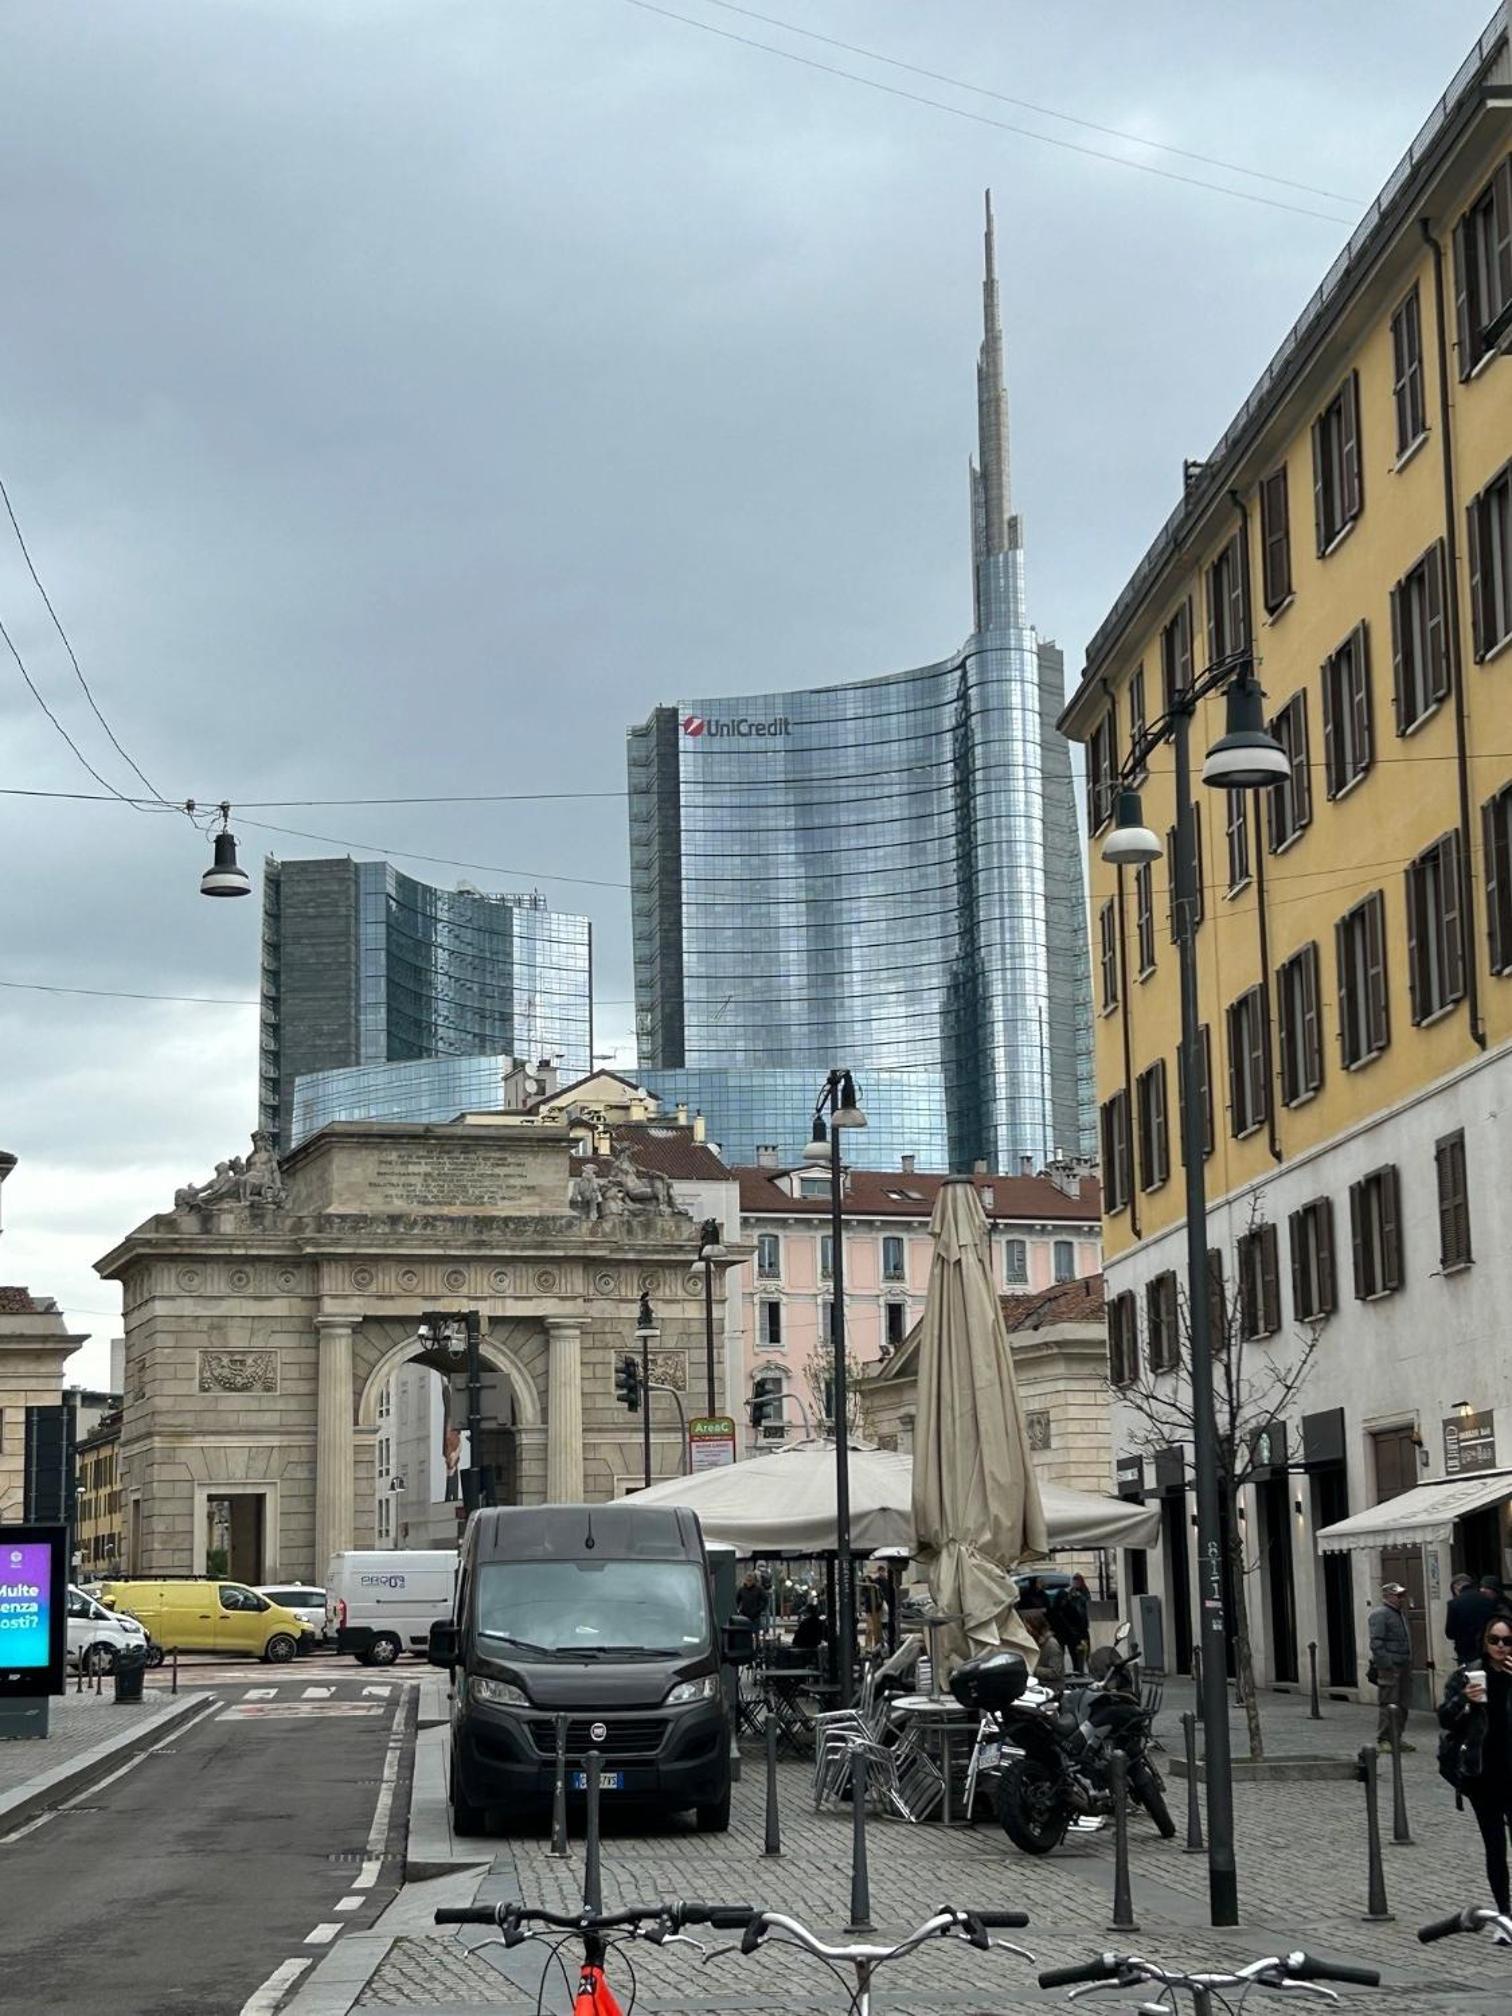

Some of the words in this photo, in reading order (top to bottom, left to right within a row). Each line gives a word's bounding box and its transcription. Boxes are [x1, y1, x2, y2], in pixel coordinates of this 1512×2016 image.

[706, 718, 791, 737] UniCredit
[0, 1603, 38, 1614] enza
[0, 1616, 39, 1629] osti?
